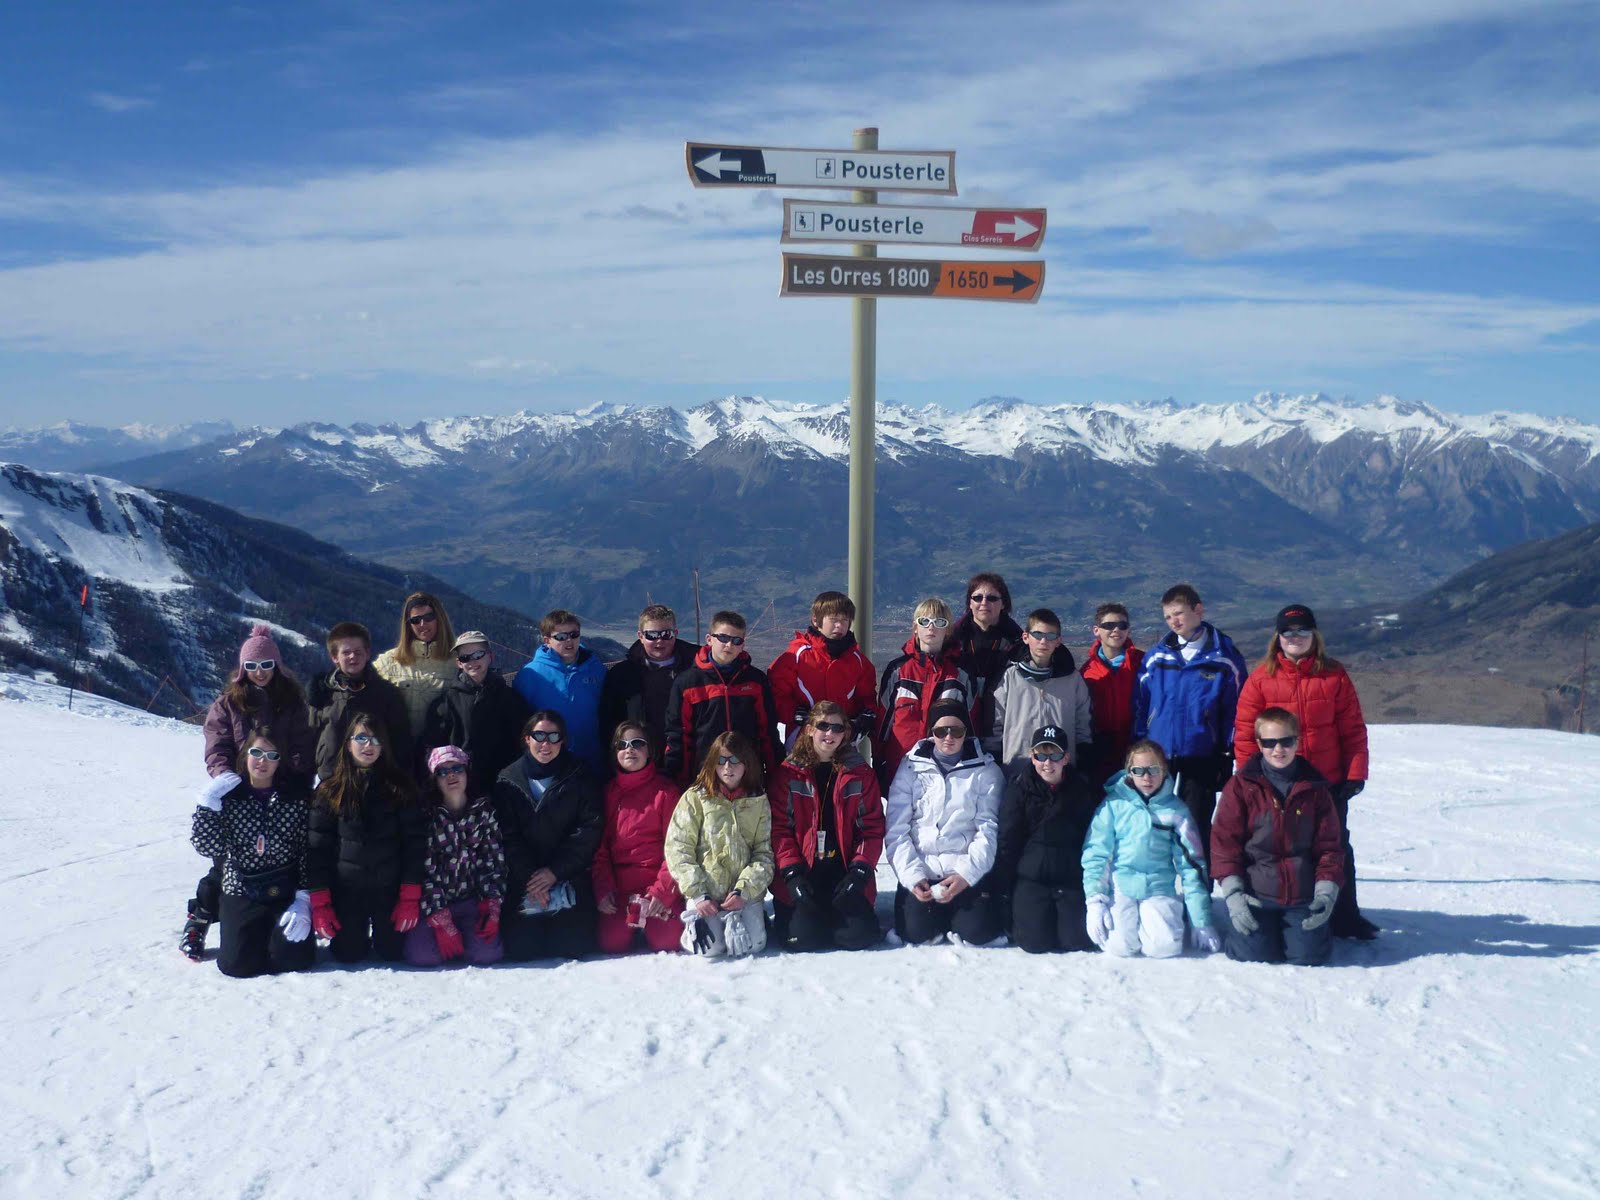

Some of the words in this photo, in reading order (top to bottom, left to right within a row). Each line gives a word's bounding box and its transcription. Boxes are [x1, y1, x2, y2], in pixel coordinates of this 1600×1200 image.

[738, 174, 775, 182] Pousterle
[842, 160, 945, 181] Pousterle
[820, 213, 924, 235] Pousterle
[963, 234, 979, 242] Clos
[793, 265, 825, 285] Les
[830, 266, 882, 286] Orres
[888, 268, 929, 288] 1800
[948, 270, 989, 289] 1650
